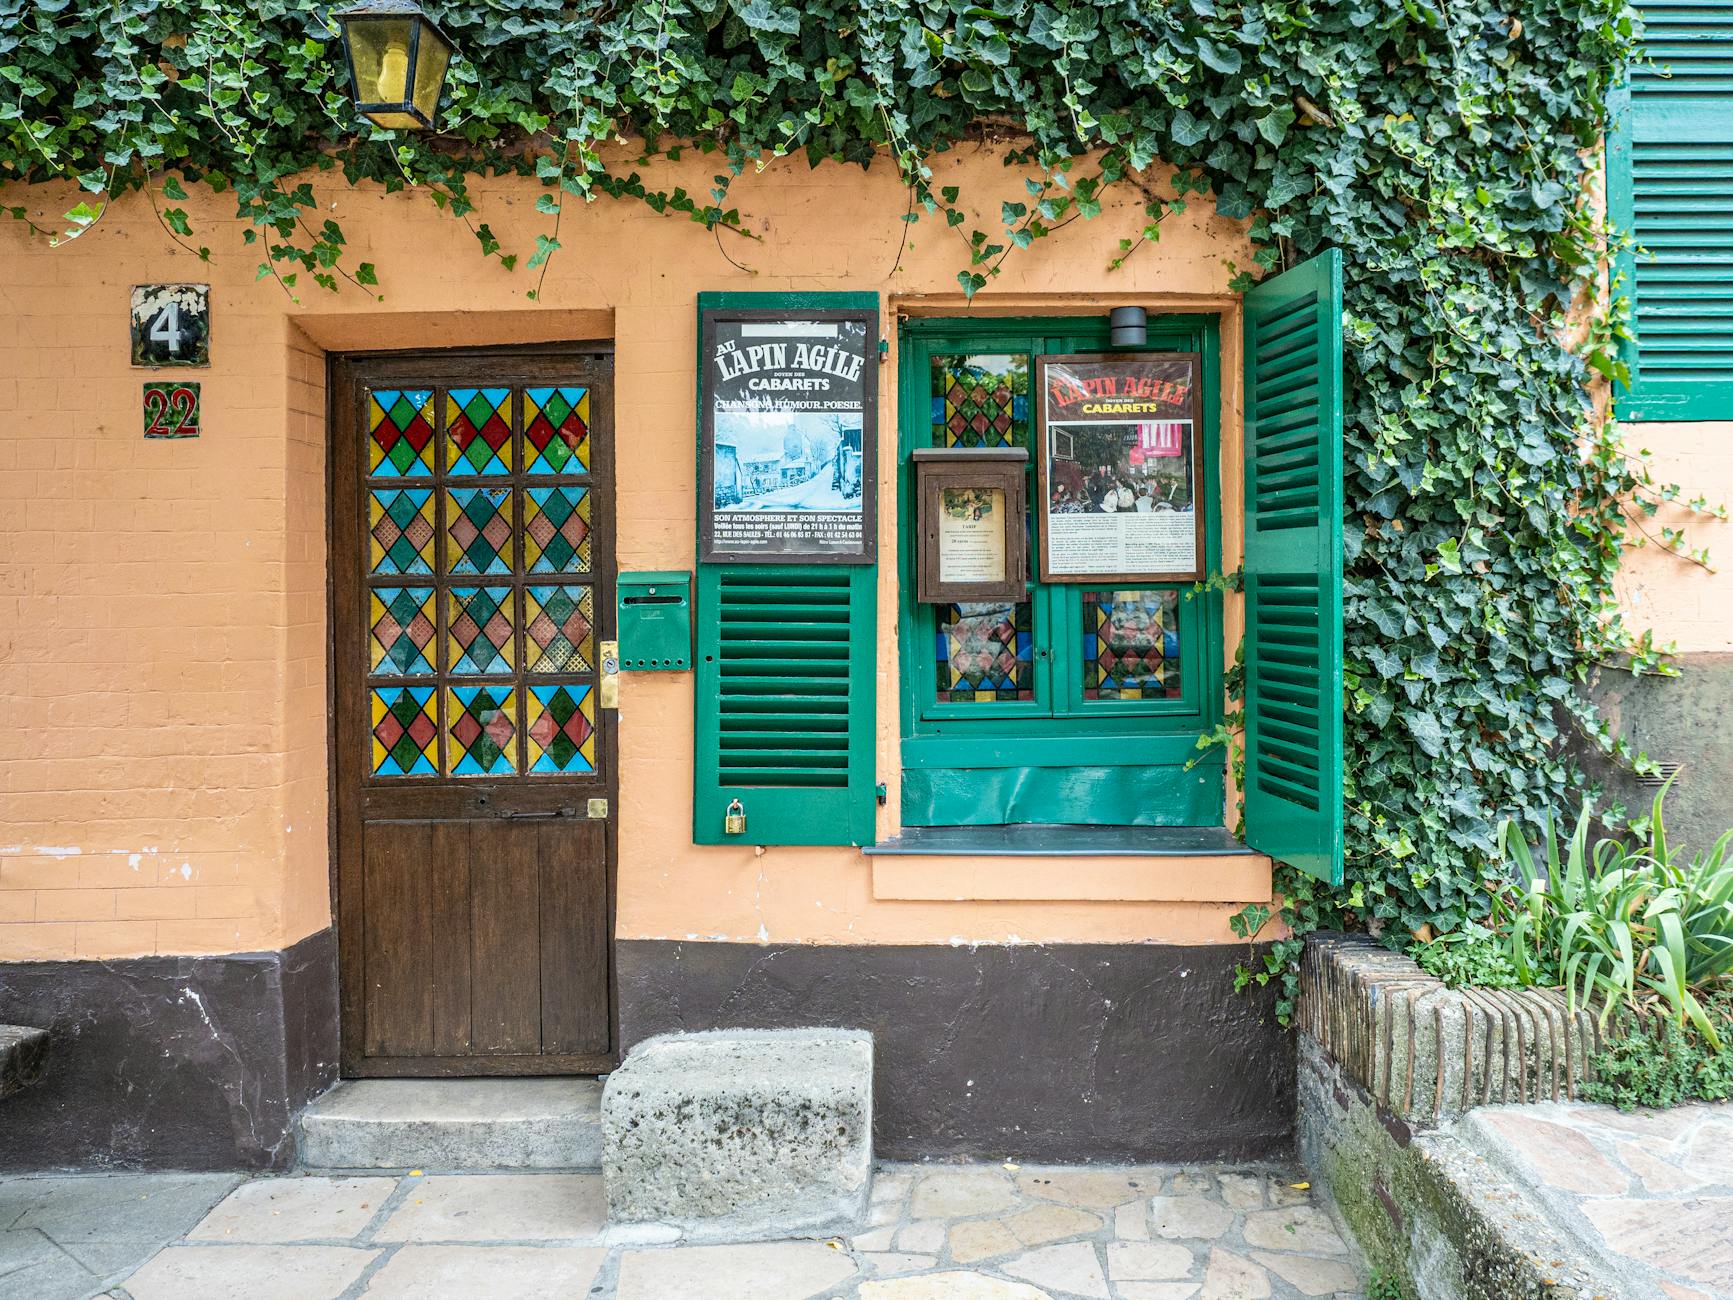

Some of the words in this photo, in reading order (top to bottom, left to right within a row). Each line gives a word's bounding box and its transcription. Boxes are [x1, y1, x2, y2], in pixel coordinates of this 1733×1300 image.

[149, 302, 182, 352] 4
[714, 343, 788, 382] LAPIN
[790, 343, 865, 382] AGILE
[715, 339, 736, 356] AU
[748, 378, 831, 391] CABARETS
[1050, 377, 1117, 408] LAPIN
[1119, 376, 1188, 406] AGILE
[143, 387, 199, 436] 22
[1082, 402, 1158, 414] CABARETS
